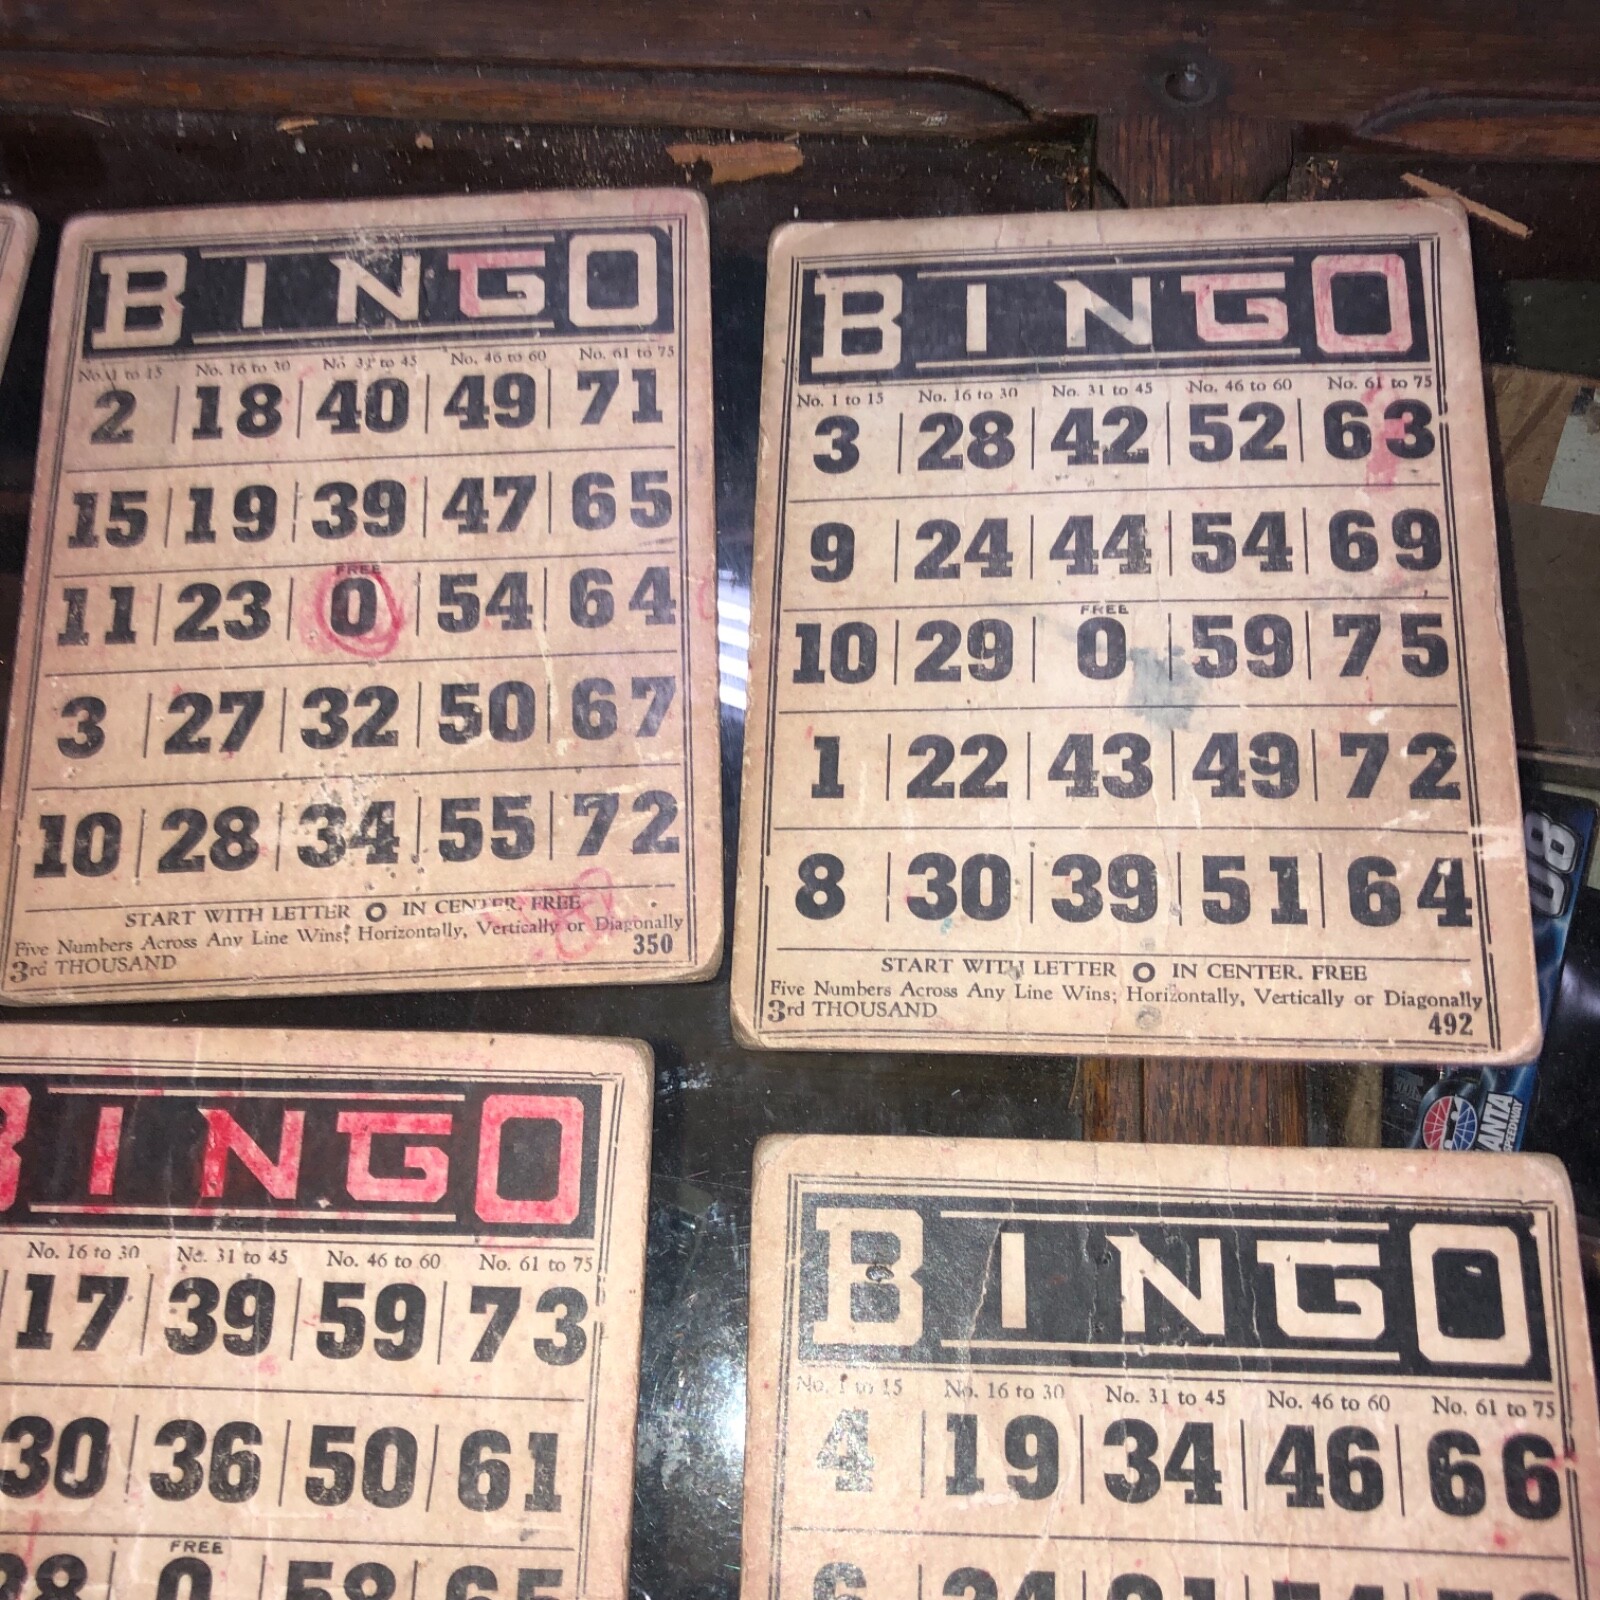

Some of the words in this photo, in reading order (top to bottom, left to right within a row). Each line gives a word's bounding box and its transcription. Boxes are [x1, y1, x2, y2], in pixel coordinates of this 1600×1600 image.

[92, 233, 659, 349] BINGO
[812, 254, 1413, 373] BINGO
[1052, 384, 1078, 398] No.
[1088, 384, 1106, 396] 31
[1113, 384, 1128, 396] to
[1135, 382, 1153, 395] 45
[1188, 380, 1217, 394] No.
[1225, 380, 1244, 393] 46
[1250, 380, 1266, 392] to
[1273, 378, 1292, 392] 60
[1327, 377, 1357, 390] No.
[1364, 376, 1383, 390] 61
[1391, 377, 1408, 389] to
[1414, 376, 1432, 389] 75
[91, 382, 136, 444] 2
[192, 383, 282, 440] 18
[316, 378, 409, 434] 40
[444, 373, 535, 430] 49
[577, 368, 663, 425] 71
[813, 416, 859, 474] 3
[918, 411, 1015, 471] 28
[1051, 406, 1149, 466] 42
[1189, 402, 1287, 462] 52
[1324, 399, 1435, 460] 63
[68, 490, 148, 548] 15
[185, 485, 277, 544] 19
[312, 480, 406, 539] 39
[442, 475, 536, 534] 47
[572, 470, 672, 530] 65
[811, 522, 855, 582] 9
[914, 518, 1013, 579] 24
[1049, 514, 1152, 575] 44
[1192, 511, 1293, 573] 54
[1329, 509, 1441, 572] 69
[57, 586, 136, 646] 11
[174, 581, 271, 642] 23
[331, 578, 377, 636] 0
[438, 572, 533, 633] 54
[570, 567, 676, 628] 64
[1081, 604, 1129, 614] FREE
[793, 622, 877, 684] 10
[914, 619, 1013, 682] 29
[1078, 617, 1128, 680] 0
[1192, 614, 1293, 678] 59
[1333, 613, 1448, 677] 75
[57, 696, 106, 758] 3
[164, 690, 265, 754] 27
[300, 686, 399, 749] 32
[439, 681, 535, 744] 50
[572, 676, 675, 740] 67
[811, 736, 844, 798] 1
[907, 734, 1008, 799] 22
[1048, 733, 1153, 798] 43
[1192, 732, 1299, 799] 49
[1339, 732, 1461, 800] 72
[33, 812, 121, 878] 10
[157, 806, 260, 873] 28
[297, 801, 400, 868] 34
[439, 795, 535, 862] 55
[573, 790, 679, 856] 72
[795, 853, 845, 920] 8
[907, 852, 1011, 921] 30
[1051, 854, 1157, 923] 39
[1202, 855, 1308, 925] 51
[1348, 856, 1472, 927] 64
[125, 911, 196, 927] START
[204, 908, 263, 923] WITH
[272, 905, 350, 921] LETTER
[402, 901, 426, 916] IN
[531, 895, 581, 910] FREE
[16, 942, 49, 956] Five
[58, 937, 133, 954] Numbers
[141, 935, 197, 950] Across
[206, 932, 243, 947] Any
[252, 930, 288, 945] Line
[358, 922, 467, 941] Horizontally,
[476, 918, 559, 936] Vertically
[567, 922, 585, 933] or
[595, 914, 683, 932] Diagonally
[633, 933, 673, 955] 350
[55, 955, 176, 974] THOUSAND
[881, 957, 953, 973] START
[1034, 960, 1116, 977] LETTER
[1173, 963, 1197, 978] IN
[1207, 963, 1303, 980] CENTER.
[1312, 965, 1367, 981] FREE
[768, 1000, 804, 1022] 3rd
[812, 1001, 937, 1018] THOUSAND
[771, 980, 804, 996] Five
[814, 980, 891, 996] Numbers
[900, 981, 958, 998] Across
[967, 982, 1005, 1002] Any
[1015, 984, 1053, 1000] Line
[1062, 985, 1117, 1004] Wins;
[1127, 984, 1245, 1007] Horizontally,
[1254, 988, 1344, 1008] Vertically
[1354, 994, 1374, 1006] or
[1384, 989, 1482, 1011] Diagonally
[1428, 1013, 1473, 1036] 492
[244, 1250, 262, 1264] to
[268, 1250, 288, 1264] 45
[328, 1250, 359, 1268] No.
[367, 1252, 388, 1268] 46
[395, 1254, 413, 1269] to
[419, 1254, 441, 1270] 60
[480, 1254, 510, 1272] No.
[520, 1256, 538, 1272] 61
[548, 1258, 566, 1272] to
[573, 1256, 592, 1273] 75
[813, 1205, 1533, 1365] BINGO
[16, 1273, 129, 1351] 17
[164, 1274, 275, 1356] 39
[316, 1281, 426, 1361] 59
[470, 1286, 588, 1366] 73
[1105, 1386, 1140, 1404] No.
[1149, 1388, 1169, 1405] 31
[1178, 1390, 1197, 1406] to
[1204, 1390, 1226, 1406] 45
[1267, 1390, 1302, 1409] No.
[1311, 1394, 1334, 1410] 46
[1341, 1396, 1360, 1411] to
[1367, 1396, 1390, 1412] 60
[1432, 1396, 1468, 1416] No.
[1476, 1399, 1498, 1416] 61
[1507, 1402, 1526, 1418] to
[1533, 1400, 1556, 1418] 75
[0, 1416, 110, 1499] 30
[149, 1420, 262, 1503] 36
[305, 1425, 417, 1508] 50
[458, 1430, 561, 1512] 61
[816, 1407, 874, 1492] 4
[946, 1413, 1059, 1500] 19
[1103, 1419, 1223, 1505] 34
[1265, 1425, 1383, 1511] 46
[1428, 1431, 1561, 1520] 66
[170, 1540, 223, 1554] FREE
